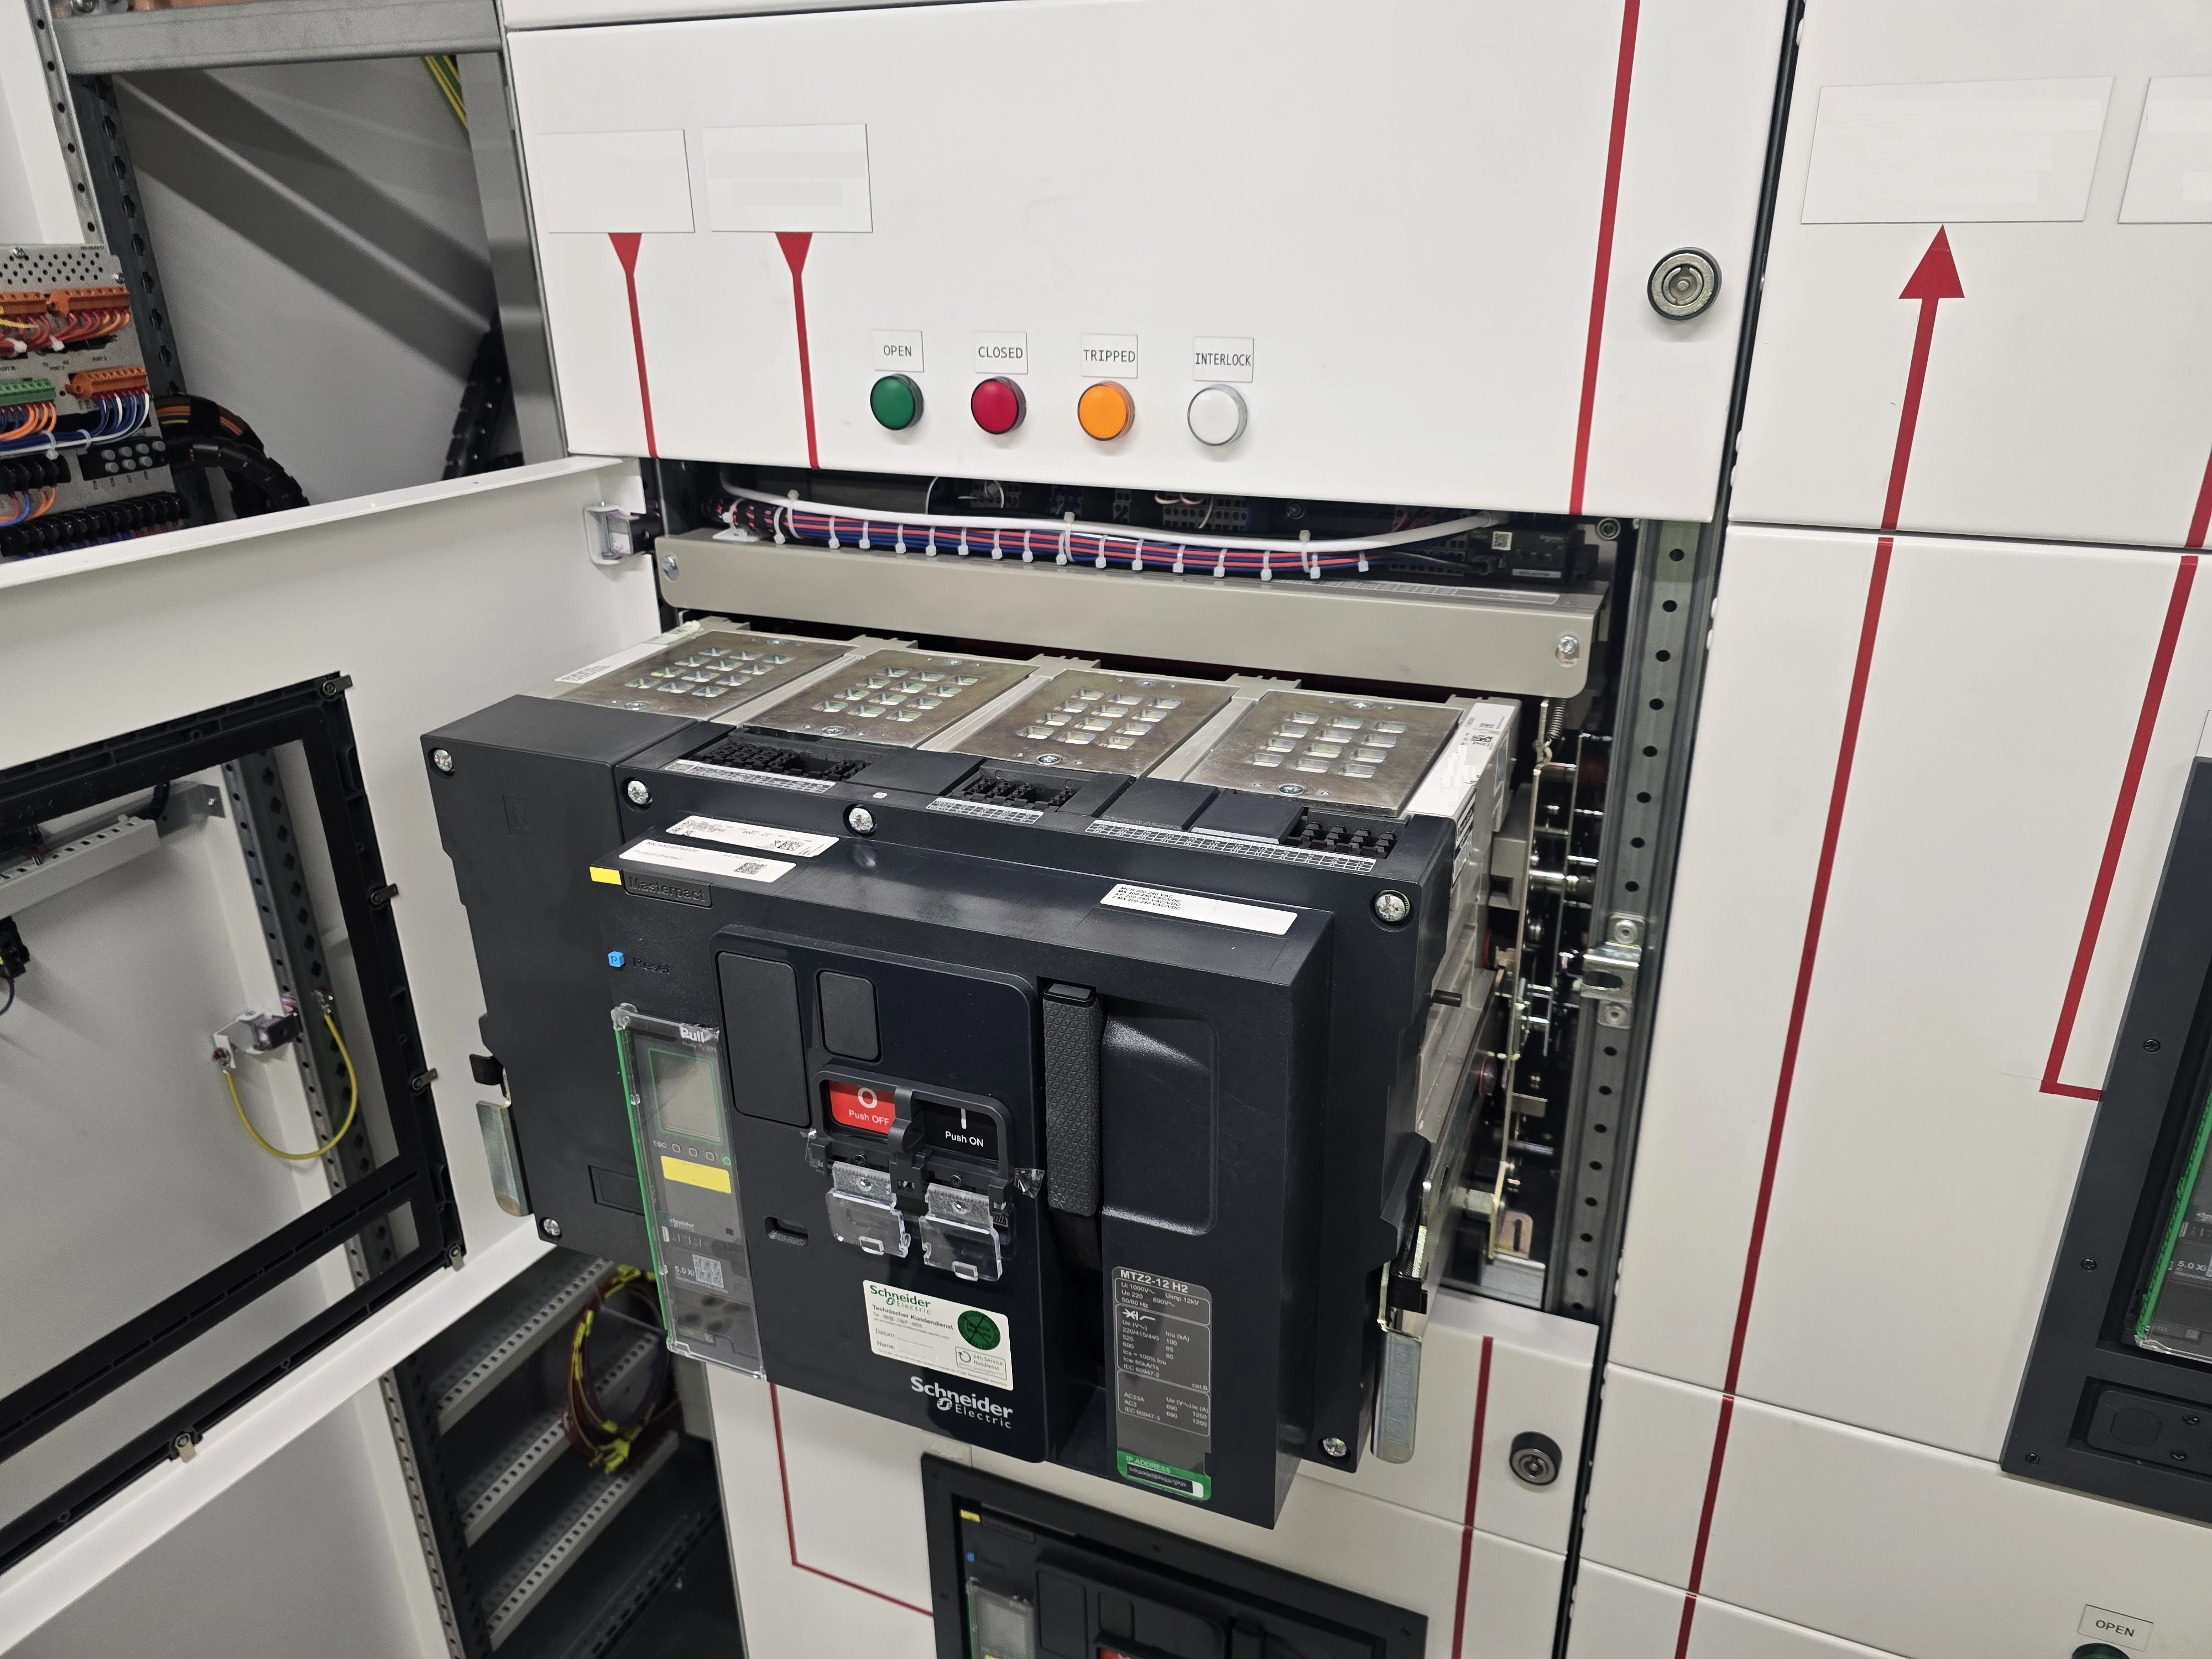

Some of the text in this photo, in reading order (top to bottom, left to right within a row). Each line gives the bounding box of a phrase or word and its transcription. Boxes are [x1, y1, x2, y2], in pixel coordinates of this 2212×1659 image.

[883, 345, 912, 357] OPEN
[978, 346, 1024, 359] CLOSED
[1083, 349, 1136, 363] TRIPPED
[1195, 352, 1252, 367] INTERLOCK
[628, 876, 707, 902] Masterpact
[611, 956, 618, 965] R
[633, 957, 671, 975] Reset
[680, 1027, 705, 1043] Pull
[849, 1109, 890, 1126] Push OFF
[653, 1140, 667, 1149] ESC
[945, 1130, 984, 1147] Push ON
[2177, 1260, 2194, 1270] 5.0
[1120, 1269, 1188, 1293] MTZ2-12 H2
[870, 1285, 931, 1308] Schneider
[1165, 1292, 1199, 1306] Uimp 12kV
[896, 1301, 931, 1314] Electric
[872, 1305, 909, 1318] Technischer
[910, 1314, 953, 1330] Kundendienst
[875, 1328, 896, 1338] Datum:
[877, 1340, 896, 1350] Name:
[1166, 1338, 1177, 1347] 100
[974, 1360, 999, 1371] Notdienst
[984, 1357, 1003, 1365] Service
[910, 1376, 1014, 1419] Schneider
[955, 1404, 1012, 1429] Electric
[1135, 1458, 1171, 1474] ADDRESS
[2095, 1619, 2135, 1637] OPEN
